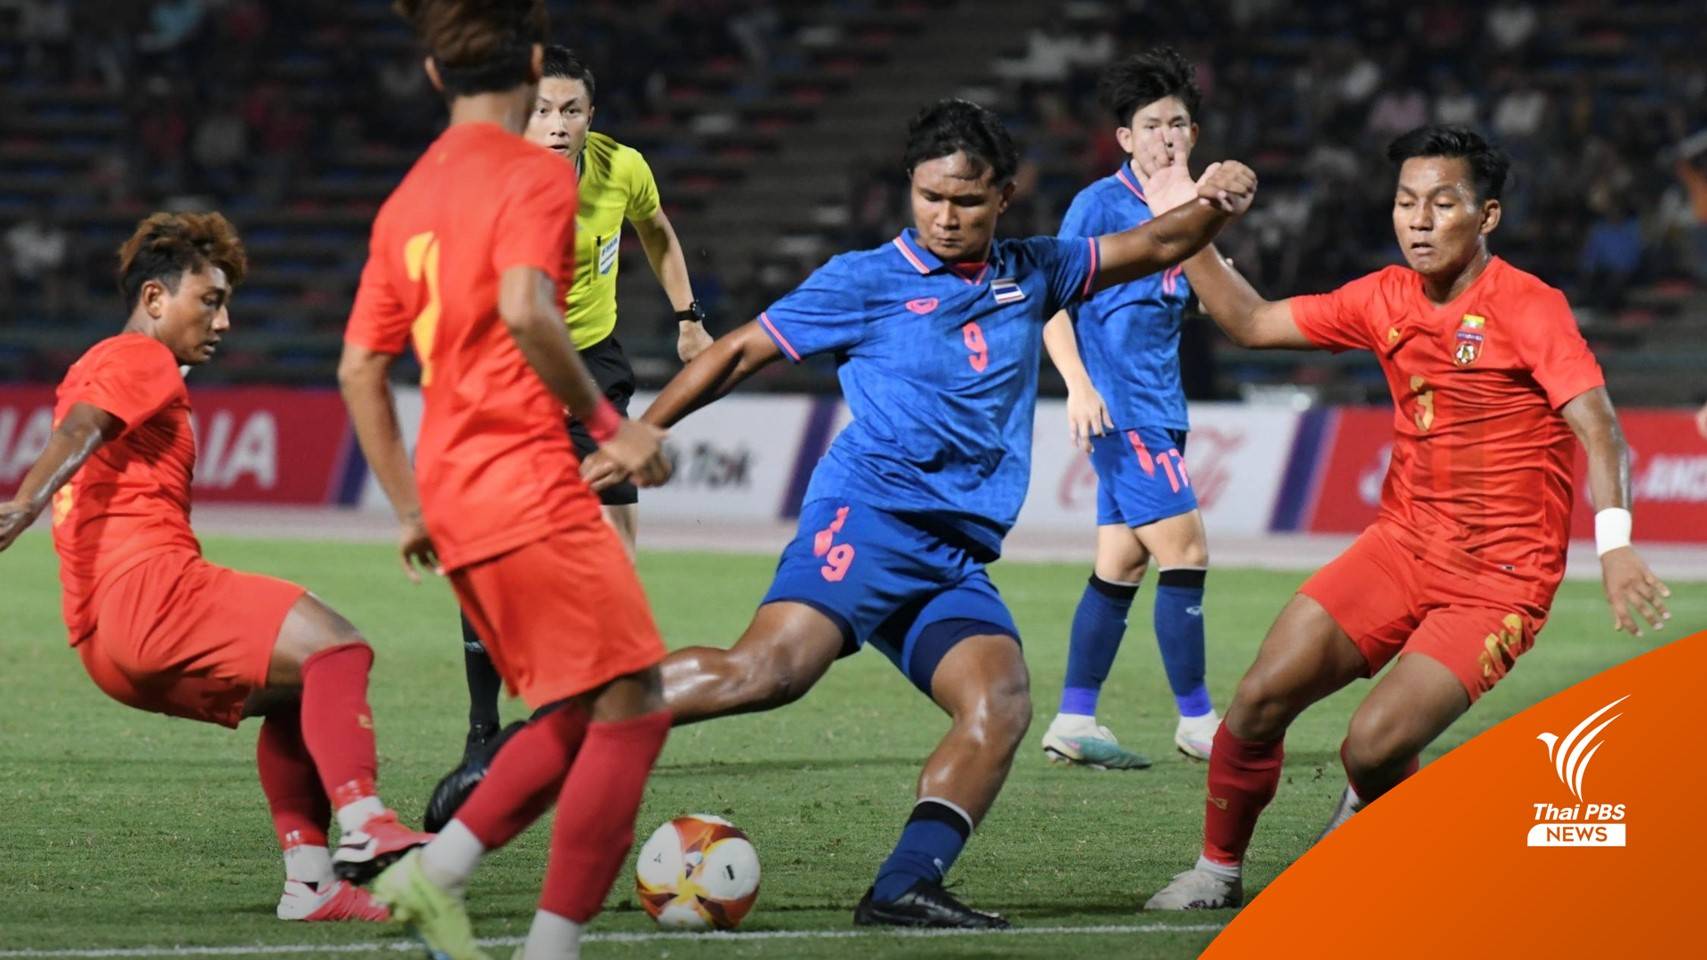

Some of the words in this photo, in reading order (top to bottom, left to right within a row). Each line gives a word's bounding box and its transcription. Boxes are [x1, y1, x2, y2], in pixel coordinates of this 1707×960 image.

[963, 322, 988, 373] 9
[1410, 375, 1434, 433] 3
[821, 543, 855, 582] 9
